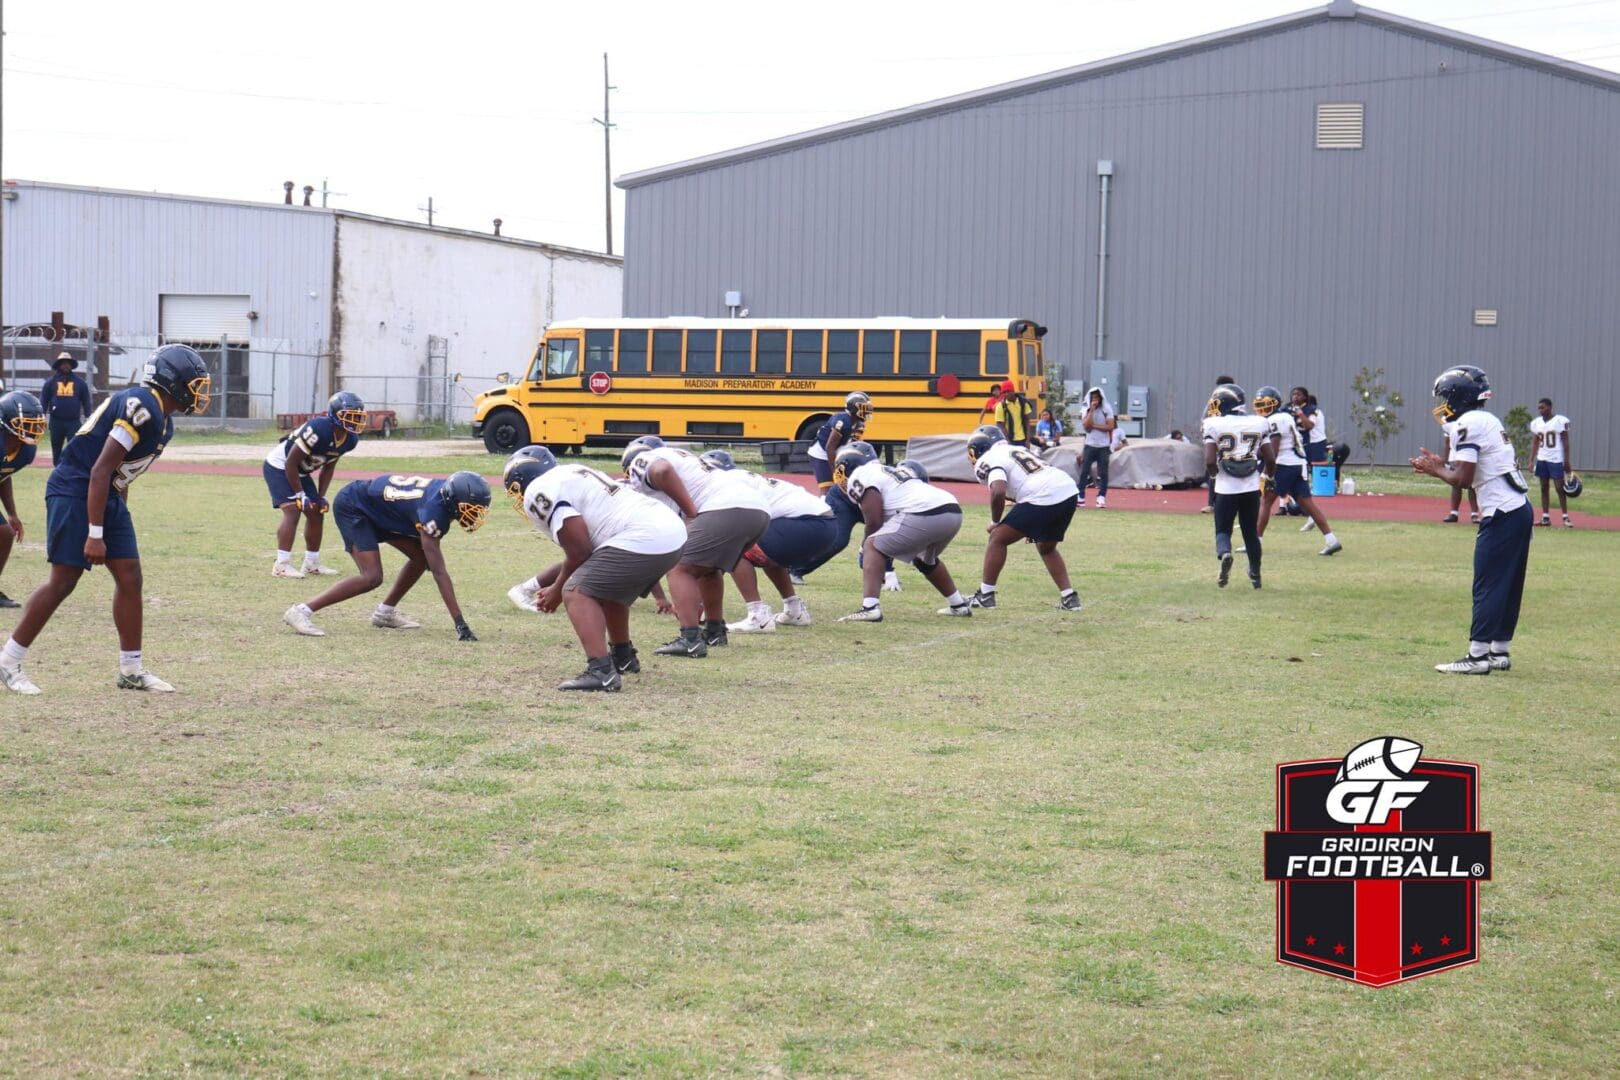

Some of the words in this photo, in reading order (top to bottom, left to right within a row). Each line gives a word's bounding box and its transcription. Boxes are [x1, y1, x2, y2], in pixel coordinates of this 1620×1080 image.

[56, 381, 74, 397] M
[591, 378, 608, 388] STOP
[684, 379, 719, 389] MADISON
[722, 380, 776, 389] PREPARATORY
[780, 380, 817, 390] ACADEMY
[1218, 431, 1262, 460] 27
[529, 492, 553, 521] 73
